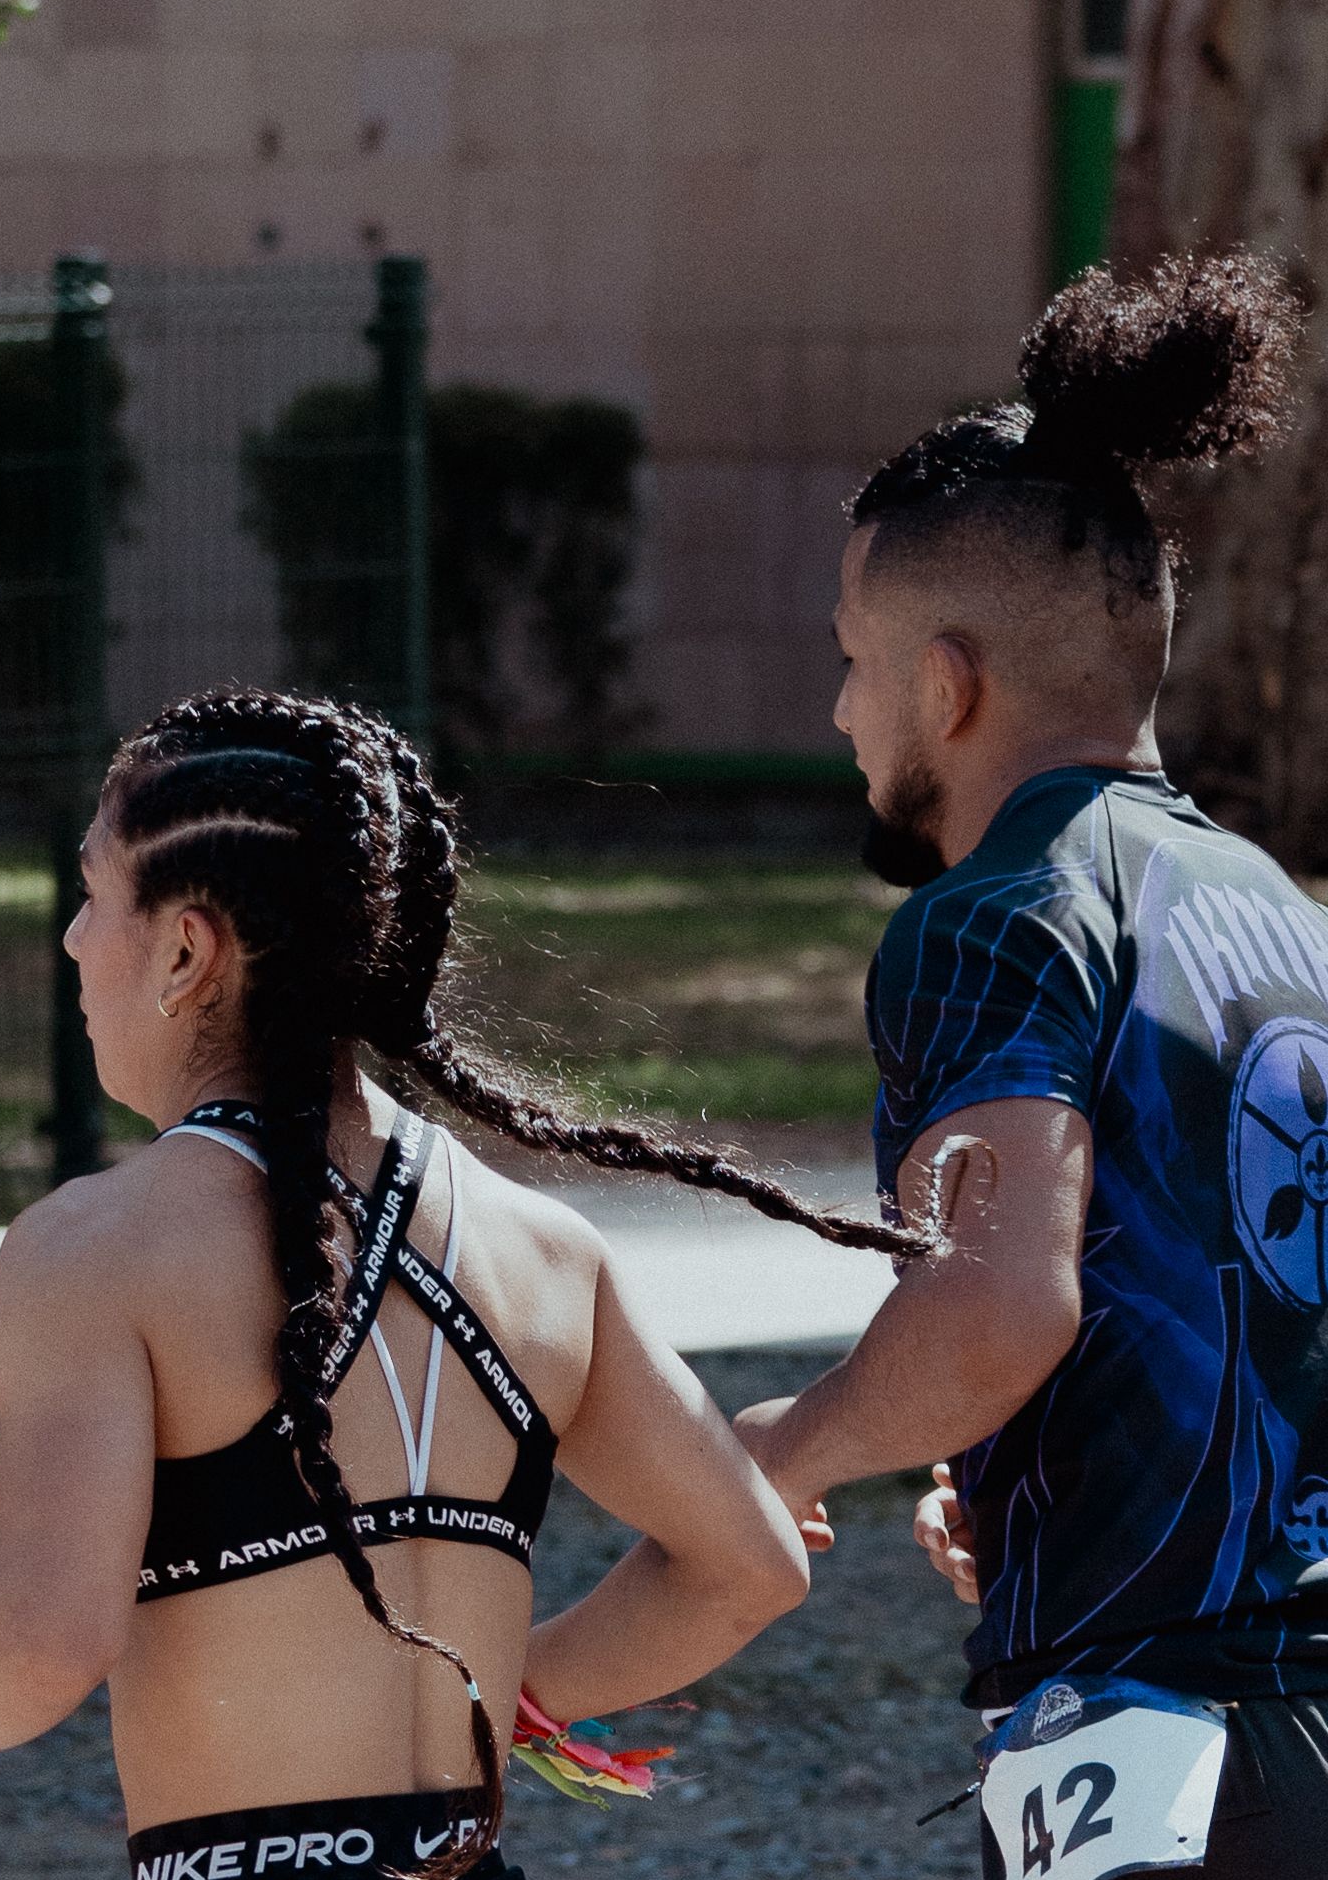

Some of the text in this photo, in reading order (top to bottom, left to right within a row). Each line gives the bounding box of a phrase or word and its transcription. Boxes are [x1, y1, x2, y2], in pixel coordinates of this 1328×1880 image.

[362, 1189, 404, 1291] ARMOUR
[218, 1506, 515, 1571] ARMOR UNDER
[253, 1828, 375, 1874] PRO
[1022, 1761, 1117, 1878] 42
